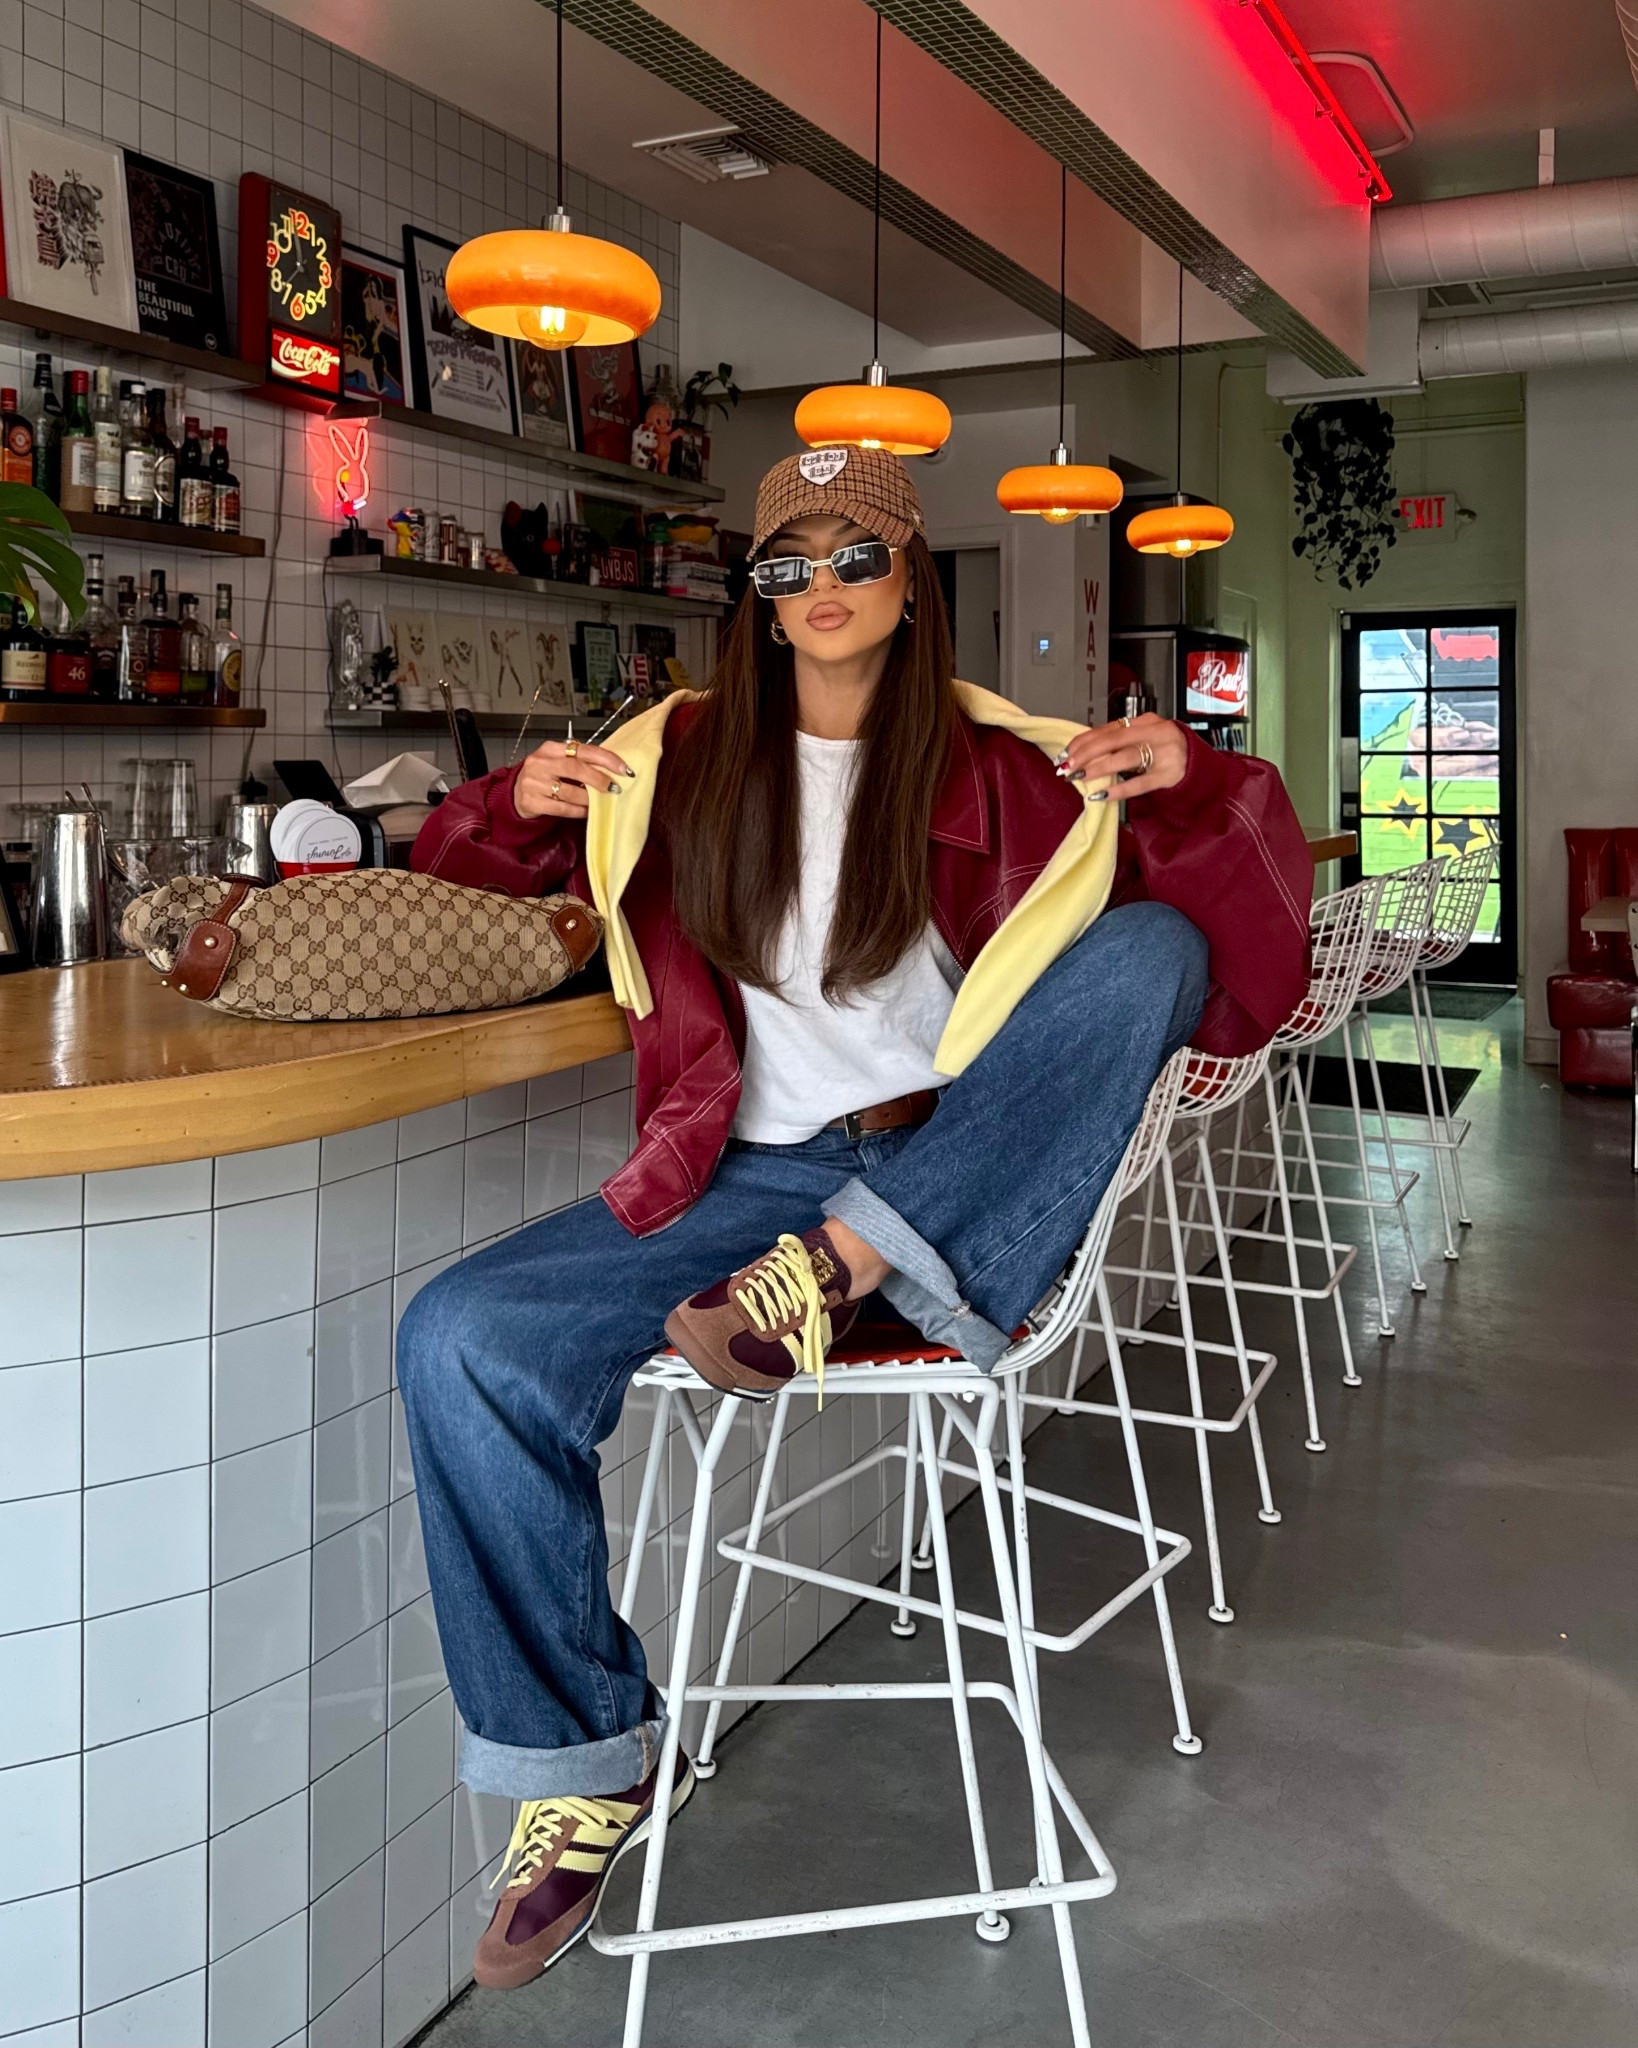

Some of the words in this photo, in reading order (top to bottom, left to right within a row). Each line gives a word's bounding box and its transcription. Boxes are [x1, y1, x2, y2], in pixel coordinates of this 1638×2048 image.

[288, 207, 310, 240] 12
[308, 223, 316, 247] 1
[270, 222, 292, 253] 10
[316, 237, 327, 261] 2
[266, 240, 280, 268] 9
[137, 278, 158, 294] THE
[270, 268, 283, 293] 8
[319, 261, 332, 289] 3
[138, 291, 195, 317] BEAUTIFUL
[282, 281, 293, 305] 7
[305, 289, 317, 315] 5
[315, 287, 327, 308] 4
[139, 304, 168, 321] ONES
[290, 292, 306, 321] 6
[1400, 497, 1446, 529] EXIT
[1084, 578, 1099, 728] WATE
[68, 666, 86, 681] 46
